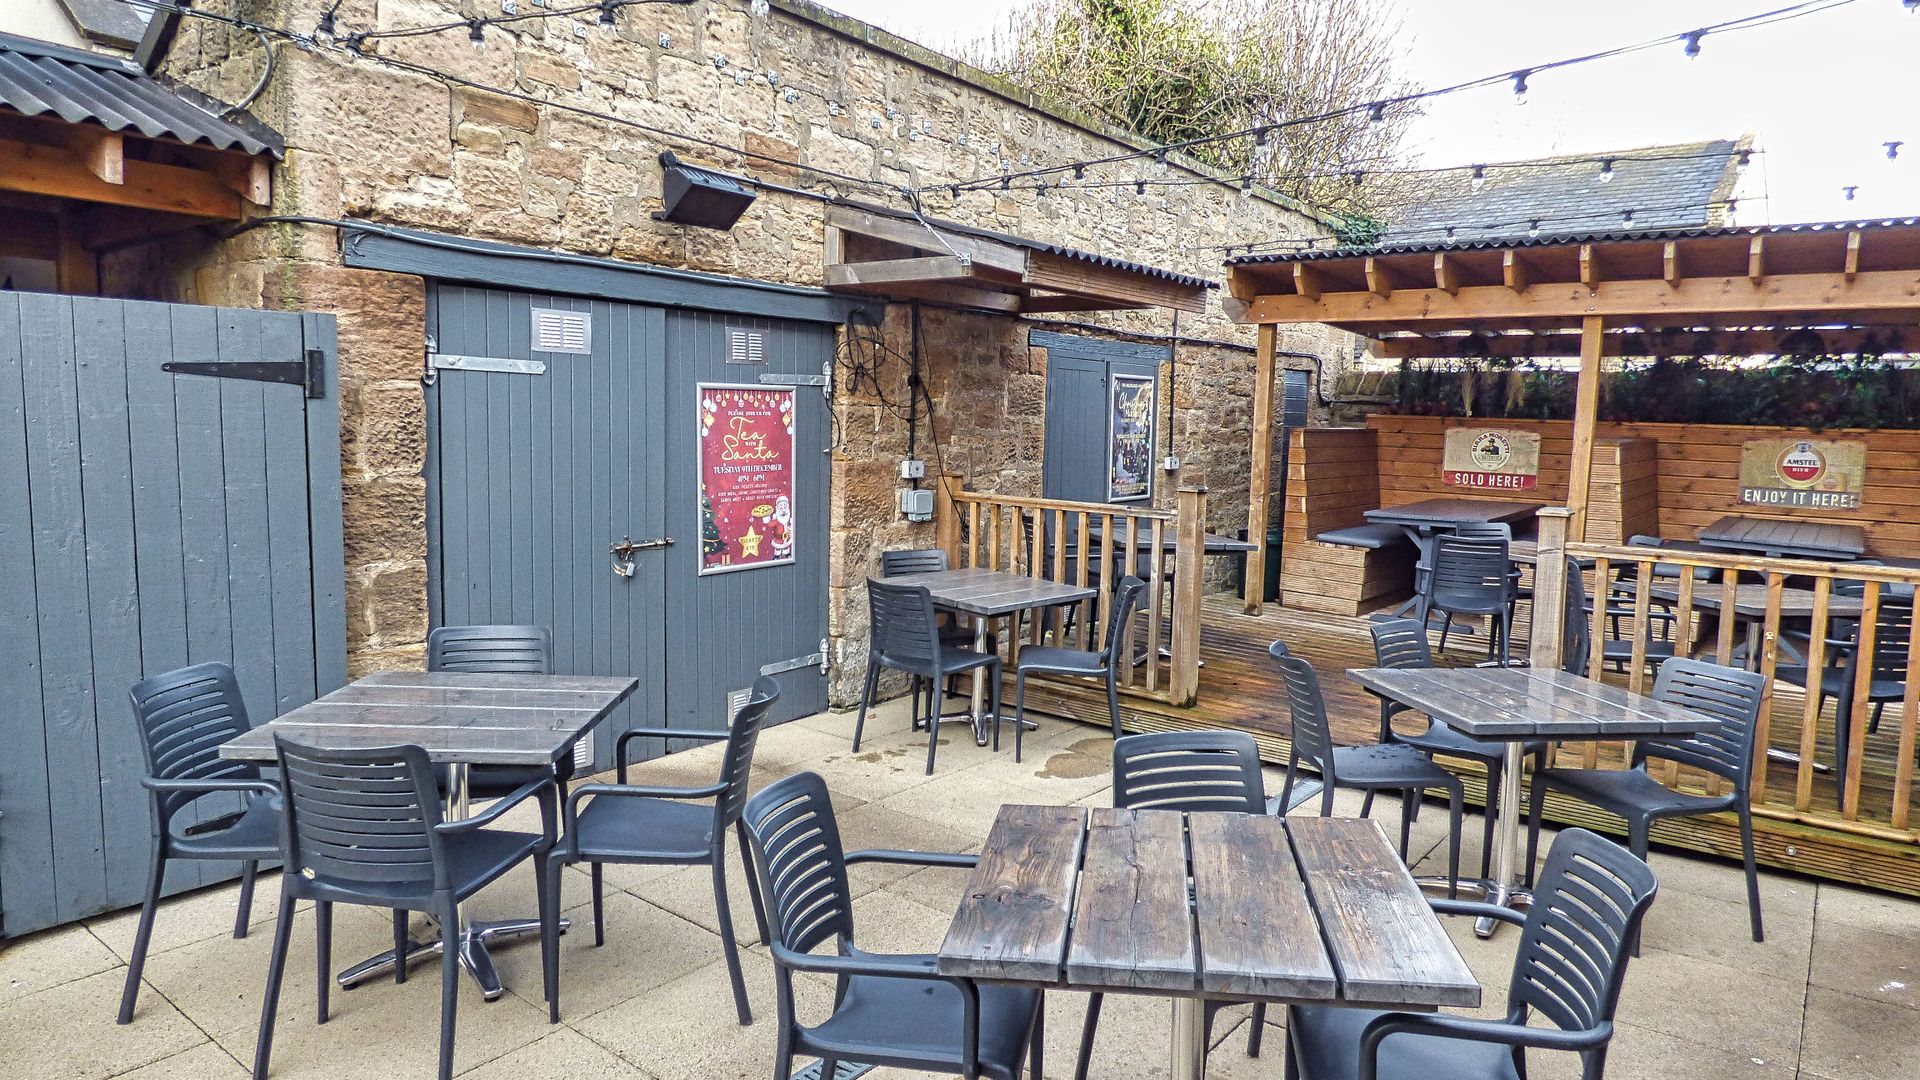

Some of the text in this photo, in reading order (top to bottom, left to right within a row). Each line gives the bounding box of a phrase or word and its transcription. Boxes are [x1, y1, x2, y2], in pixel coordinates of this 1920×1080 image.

[729, 416, 766, 440] Tea
[721, 434, 779, 461] Santa
[1472, 433, 1510, 454] BIRRA MORETTI
[713, 466, 741, 474] TUESDAY
[753, 464, 782, 472] DECEMBER
[1455, 473, 1525, 488] SOLD HERE!
[1744, 489, 1788, 502] ENJOY
[1793, 492, 1808, 505] IT
